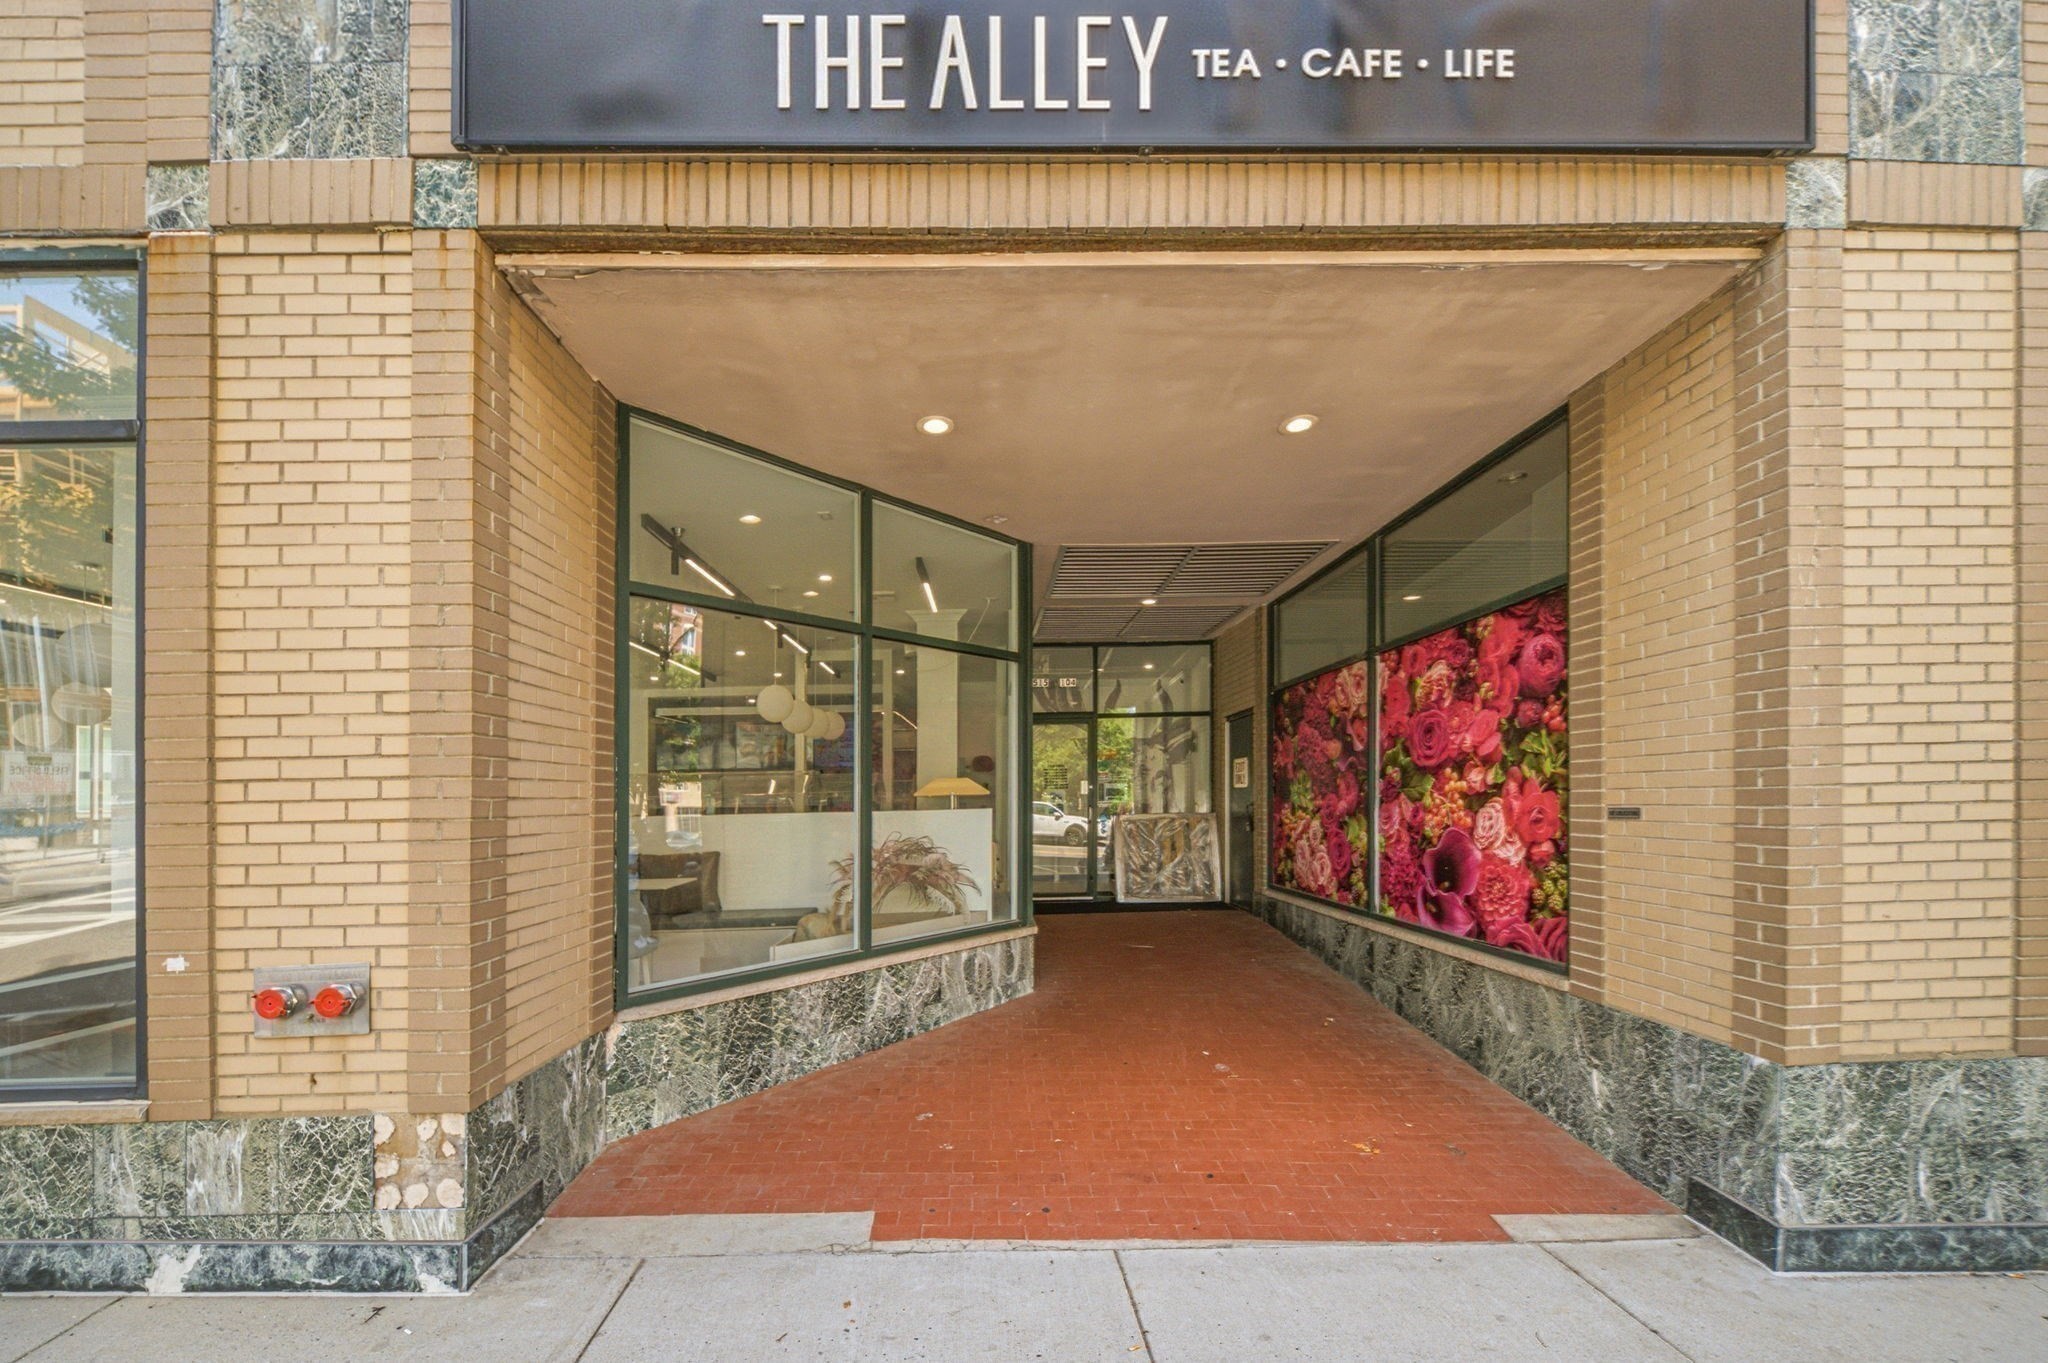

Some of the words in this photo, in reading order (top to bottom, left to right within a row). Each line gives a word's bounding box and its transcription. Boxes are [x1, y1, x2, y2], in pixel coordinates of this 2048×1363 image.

[762, 14, 906, 109] THE
[929, 14, 1168, 110] ALLEY
[1192, 48, 1261, 77] TEA
[1302, 48, 1402, 78] CAFE
[1445, 49, 1514, 78] LIFE
[1032, 678, 1049, 687] 515
